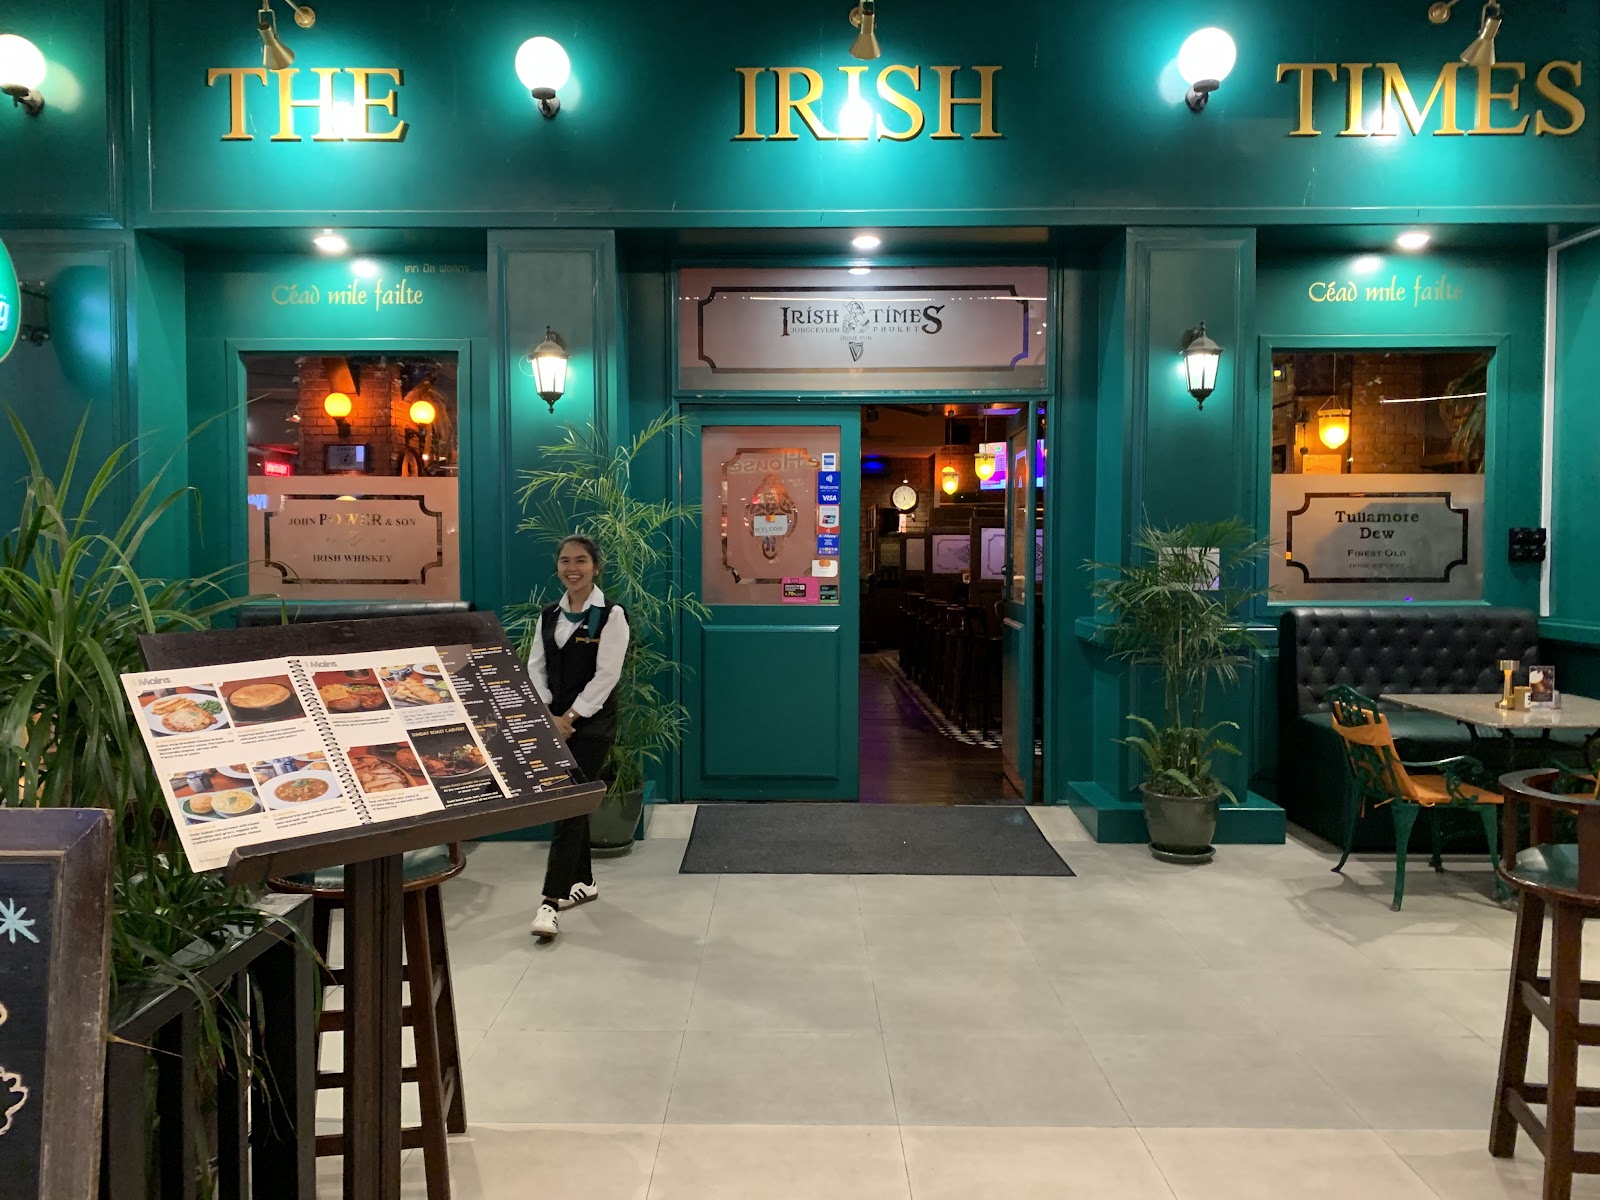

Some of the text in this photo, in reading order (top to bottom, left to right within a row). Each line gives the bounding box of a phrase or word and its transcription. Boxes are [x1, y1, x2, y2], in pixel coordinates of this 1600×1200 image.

[206, 60, 1586, 141] THE IRISH TIMES
[1365, 275, 1405, 301] mile
[328, 279, 367, 305] mile
[374, 279, 423, 311] failte
[288, 513, 416, 526] JOHN POWER & SON
[1335, 510, 1420, 523] Tullamore
[1360, 527, 1395, 539] Dew
[313, 554, 393, 562] IRISH WHISKEY
[1347, 549, 1406, 557] FINEST OLD
[310, 660, 338, 668] Mains
[138, 676, 172, 686] Mains
